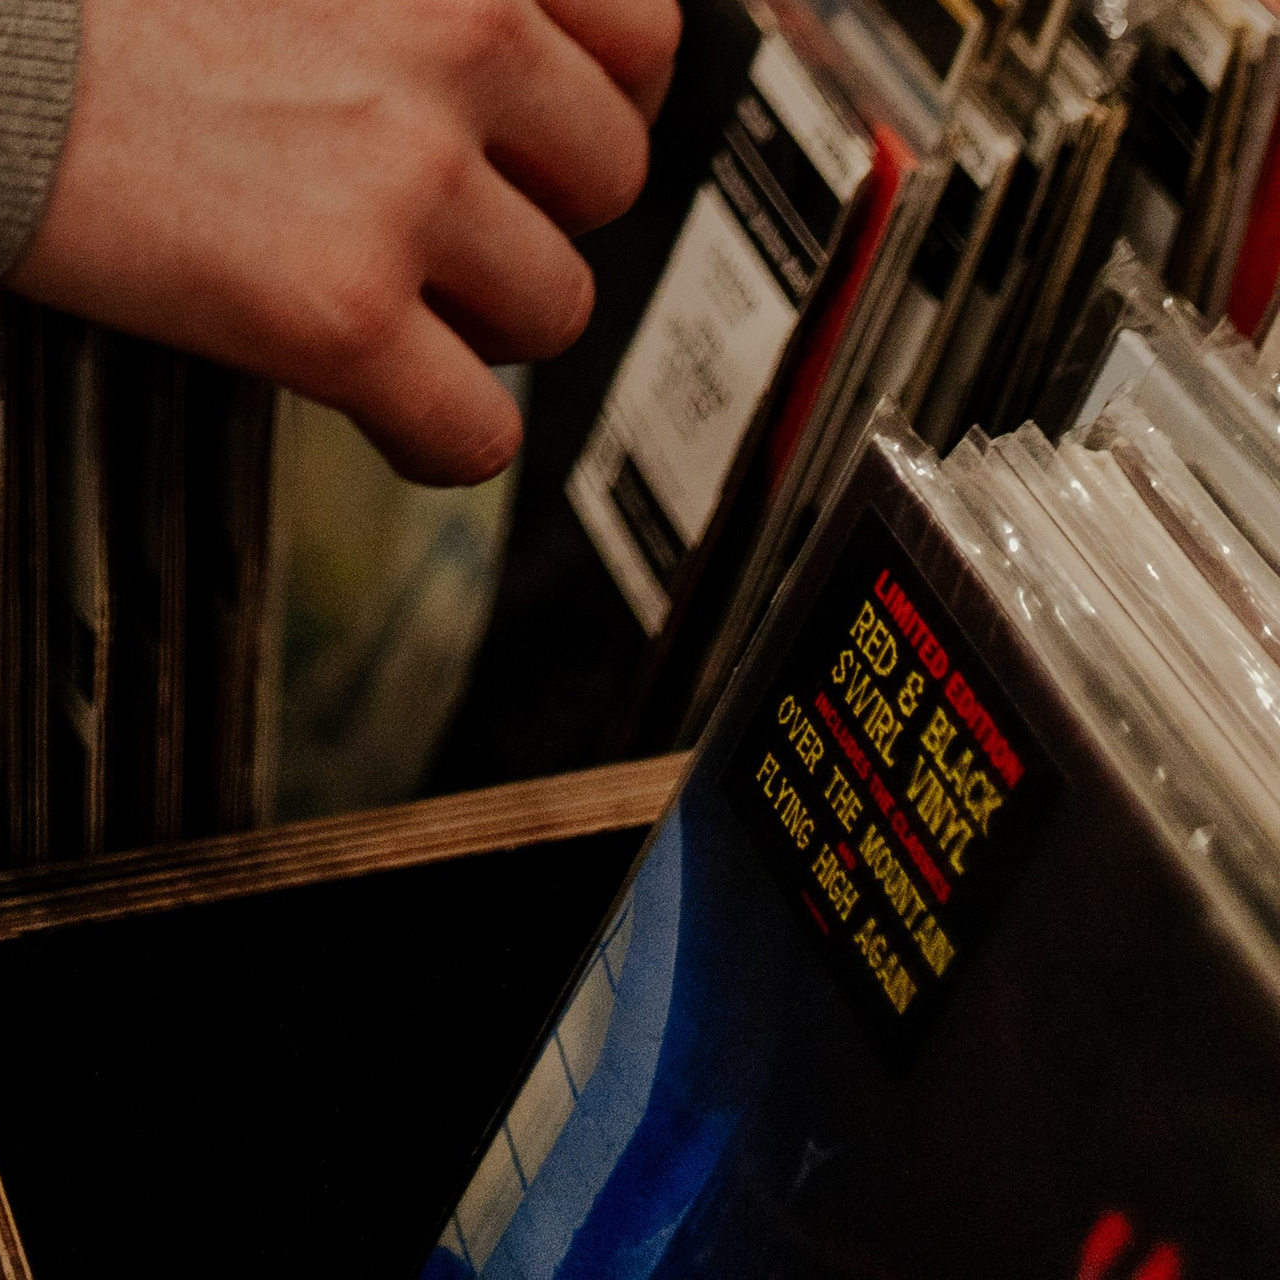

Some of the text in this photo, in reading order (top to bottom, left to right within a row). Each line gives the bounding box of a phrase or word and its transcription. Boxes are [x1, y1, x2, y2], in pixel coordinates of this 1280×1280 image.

[815, 692, 871, 780] INCLUDES
[870, 773, 895, 816] THE
[831, 650, 974, 874] SWIRL VINYL
[849, 601, 1003, 834] RED & BLACK
[874, 569, 1024, 788] LIMITED EDITION
[756, 753, 815, 849] FLYING
[812, 844, 859, 921] HIGH
[854, 918, 916, 1014] AGAIN
[778, 695, 954, 975] OVER THE MOUNTAIN
